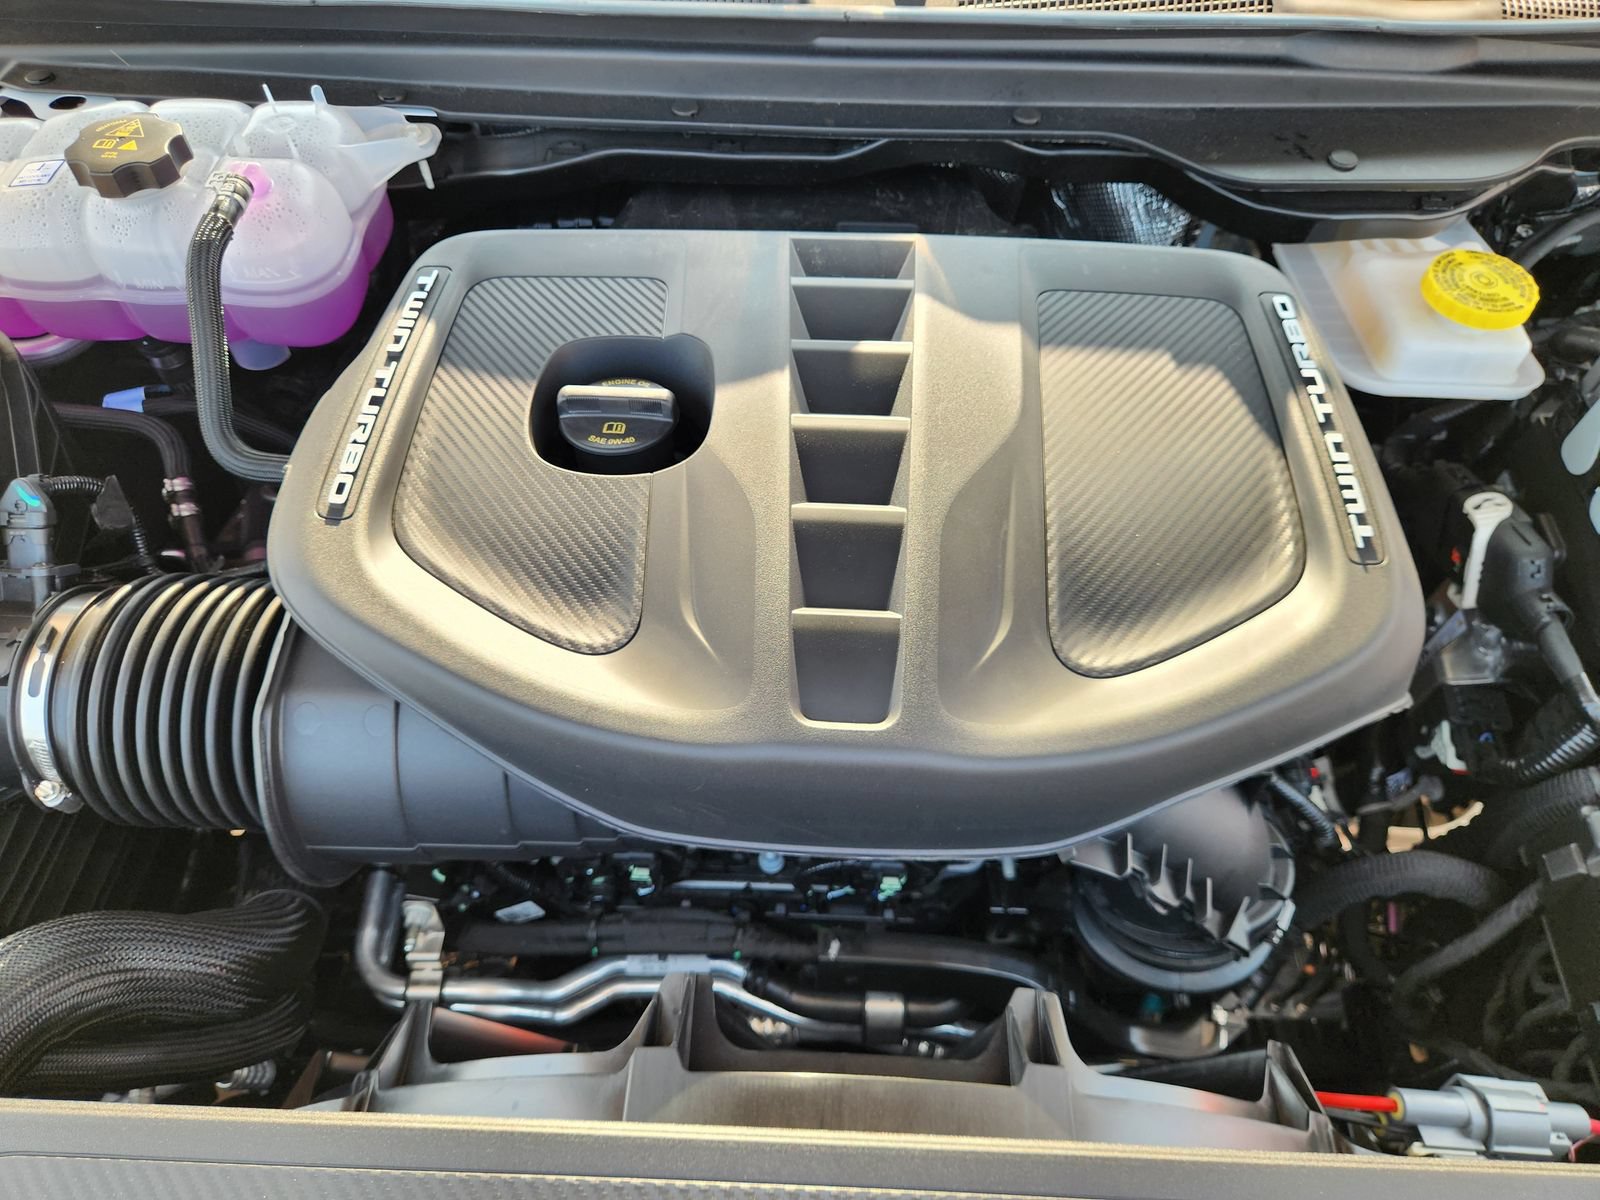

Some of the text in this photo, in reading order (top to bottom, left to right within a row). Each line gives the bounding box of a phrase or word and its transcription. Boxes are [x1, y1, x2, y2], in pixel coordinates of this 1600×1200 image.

[327, 269, 439, 505] TWIN TURBO
[588, 435, 635, 445] SAE 0W-40
[1271, 294, 1375, 549] TWIN TURBO
